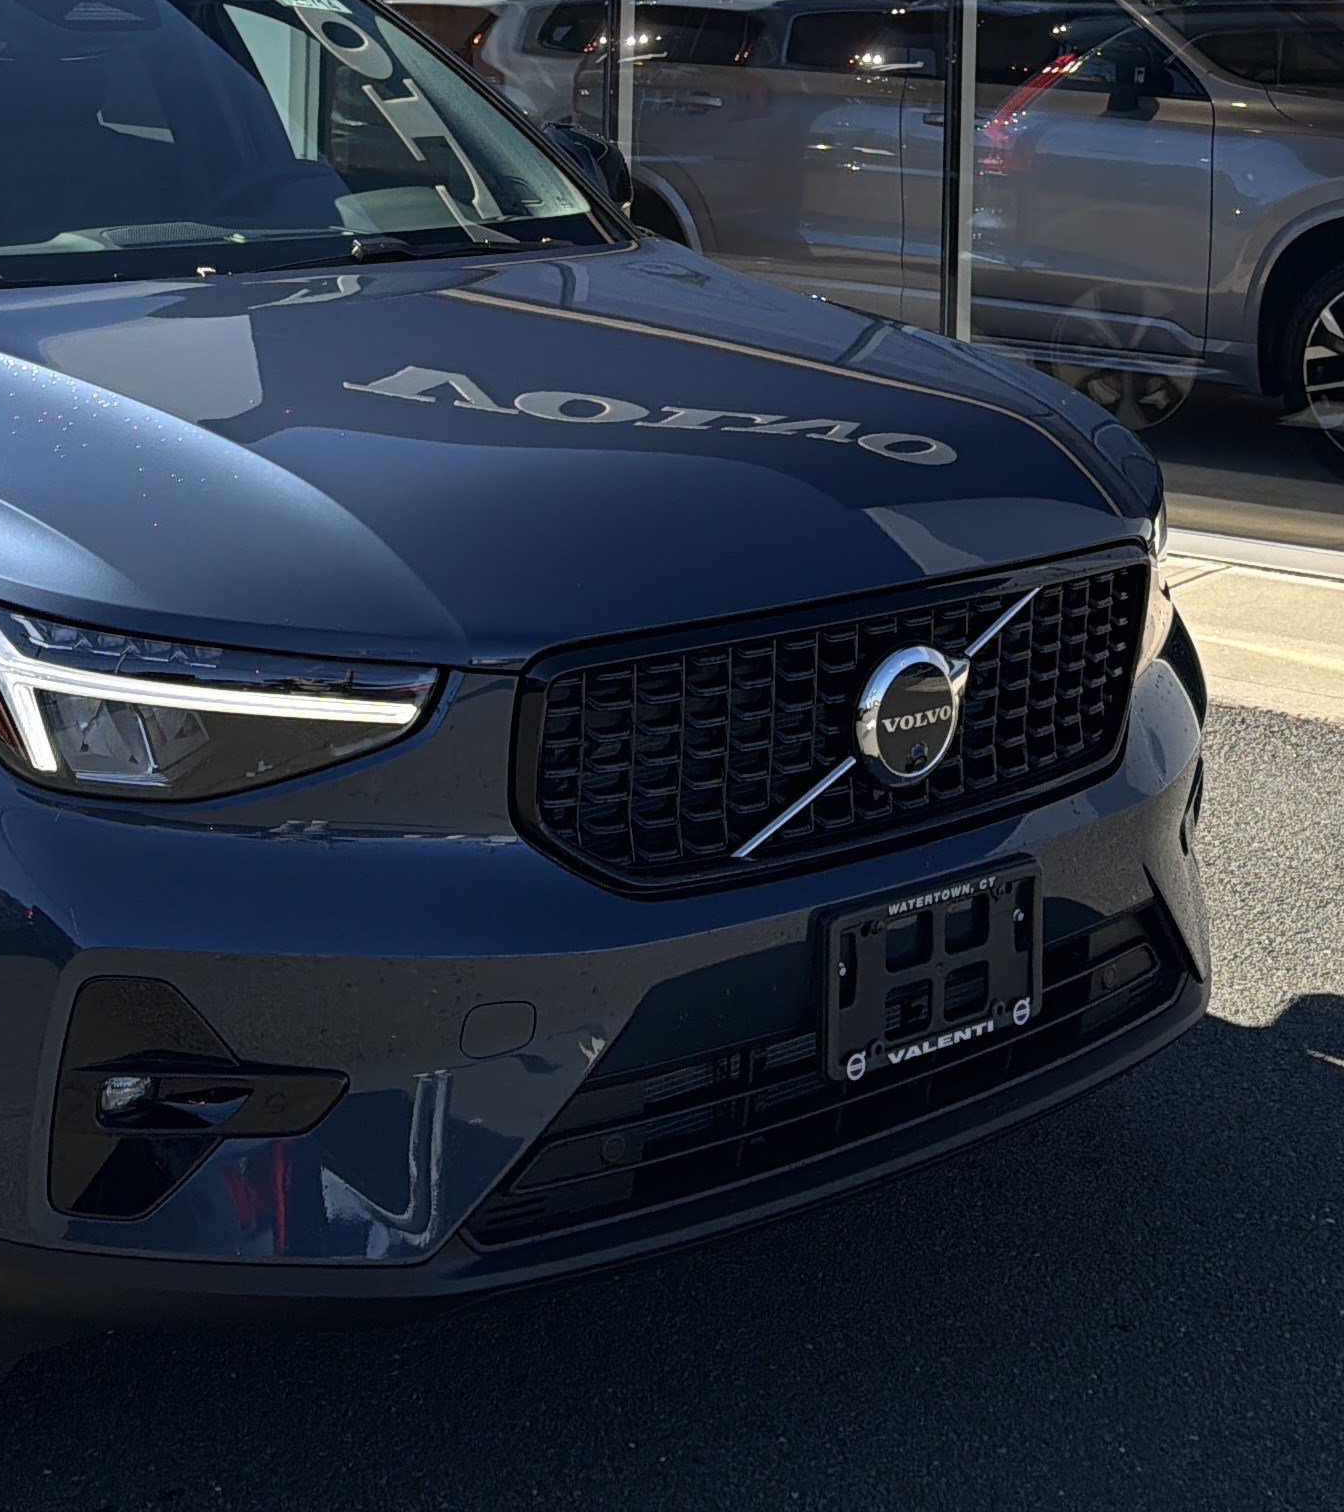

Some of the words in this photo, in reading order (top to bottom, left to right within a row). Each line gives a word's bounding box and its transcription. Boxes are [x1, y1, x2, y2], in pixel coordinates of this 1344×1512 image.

[881, 705, 952, 733] VOLVO
[888, 883, 975, 916] WATERTOWN,
[979, 876, 996, 890] CT
[887, 1020, 994, 1065] VALENTI
